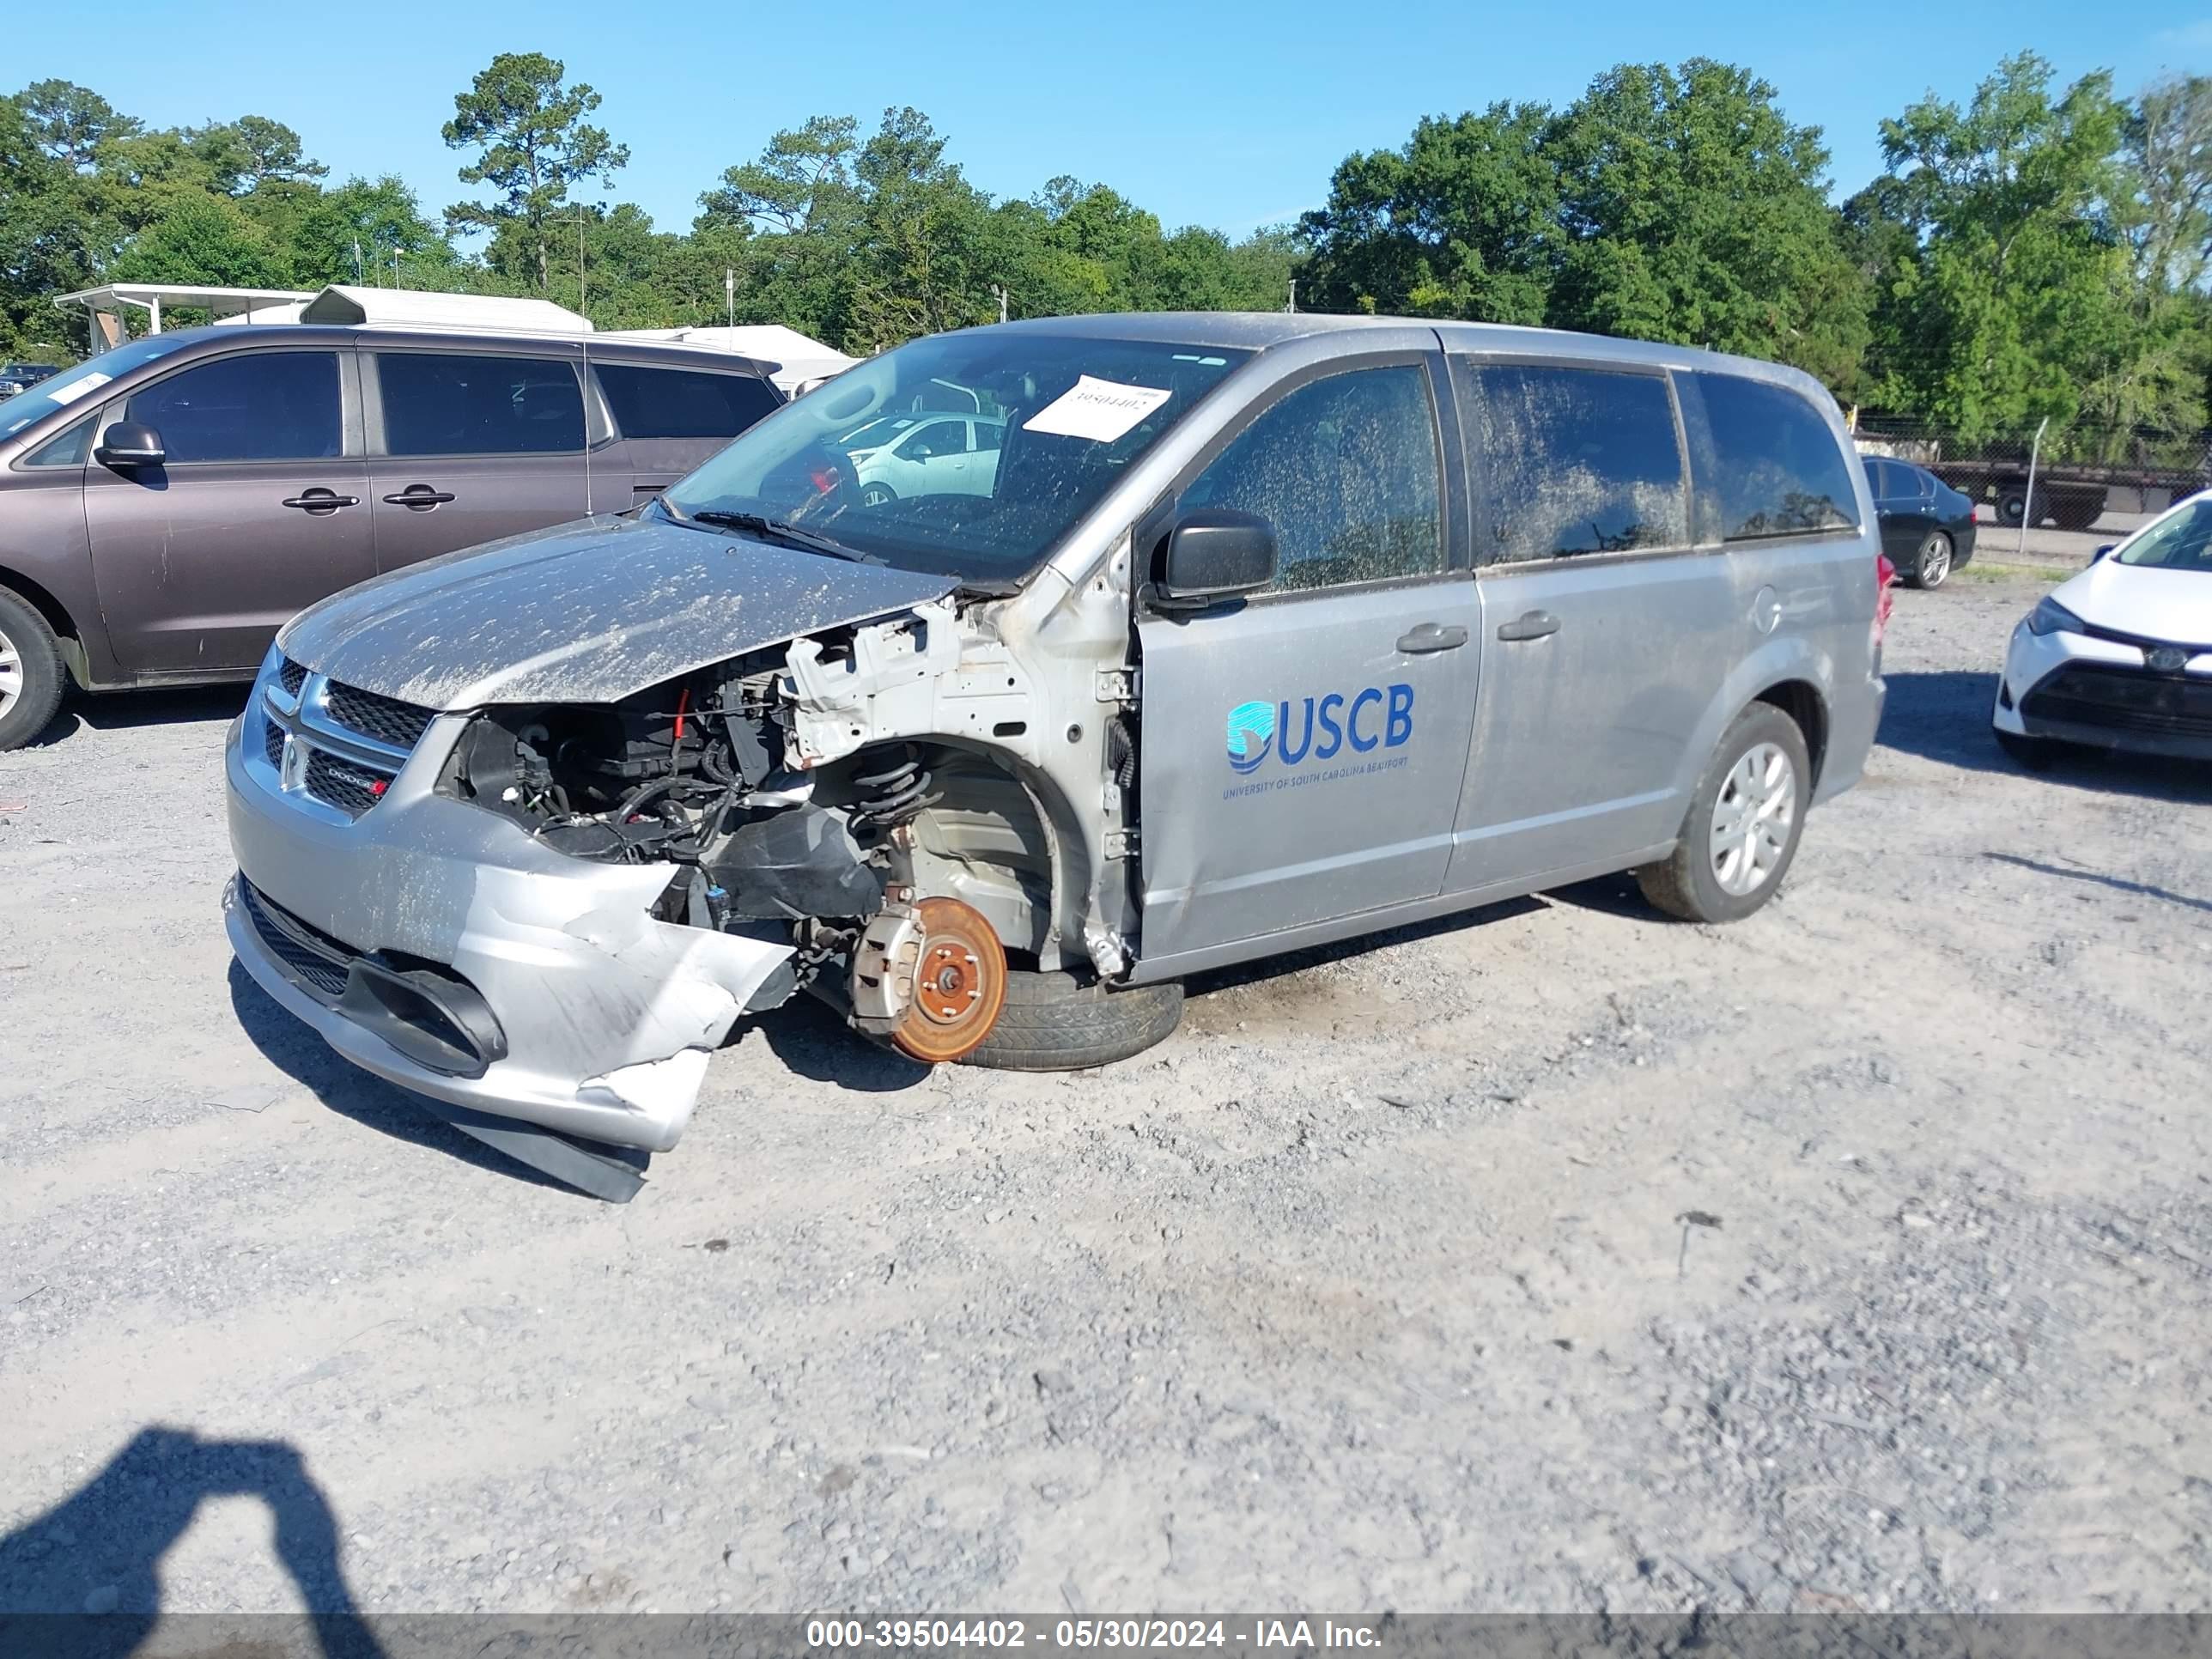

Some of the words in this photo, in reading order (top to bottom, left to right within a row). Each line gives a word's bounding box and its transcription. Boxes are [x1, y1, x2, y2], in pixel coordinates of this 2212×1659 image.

[1278, 684, 1414, 765] USCB
[1223, 781, 1274, 799] UNIVERSITY
[1276, 778, 1290, 790] OF
[1291, 774, 1320, 787] SOUTH
[1322, 767, 1364, 781] CAROLINA
[1366, 757, 1408, 773] BEAUFORT
